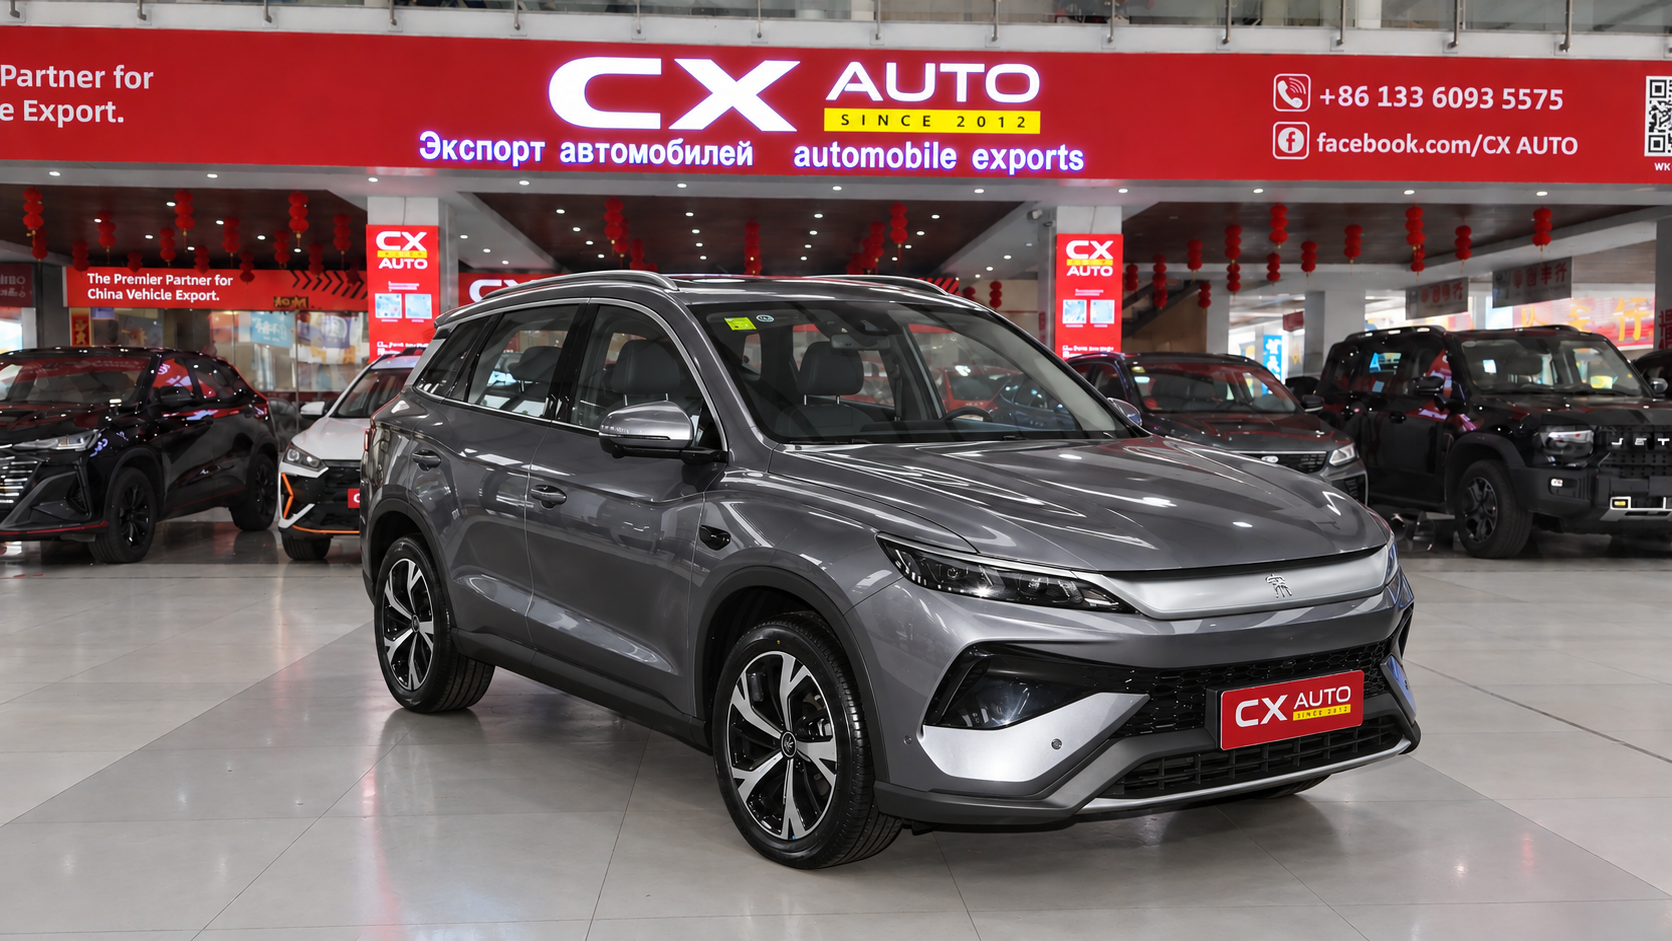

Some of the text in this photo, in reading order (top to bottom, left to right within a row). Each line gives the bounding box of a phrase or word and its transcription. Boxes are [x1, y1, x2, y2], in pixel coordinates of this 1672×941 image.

[1, 64, 154, 89] Partner for
[549, 56, 1040, 132] CX AUTO
[1319, 85, 1563, 110] +86 133 6093 5575
[23, 99, 124, 128] Export.
[840, 113, 1026, 129] SINCE 2012
[419, 130, 754, 167] Экспорт автомобилей
[1316, 132, 1578, 158] facebook.com/CX AUTO
[793, 141, 1084, 175] automobile exports
[376, 231, 427, 251] CX
[1066, 240, 1113, 260] CX
[378, 257, 428, 269] AUTO
[1066, 265, 1113, 277] AUTO
[87, 273, 234, 286] The Premier Partner for
[469, 279, 519, 303] C
[87, 288, 220, 303] China Vehicle Export.
[1235, 685, 1352, 728] CX AUTO
[1297, 709, 1322, 719] SINCE
